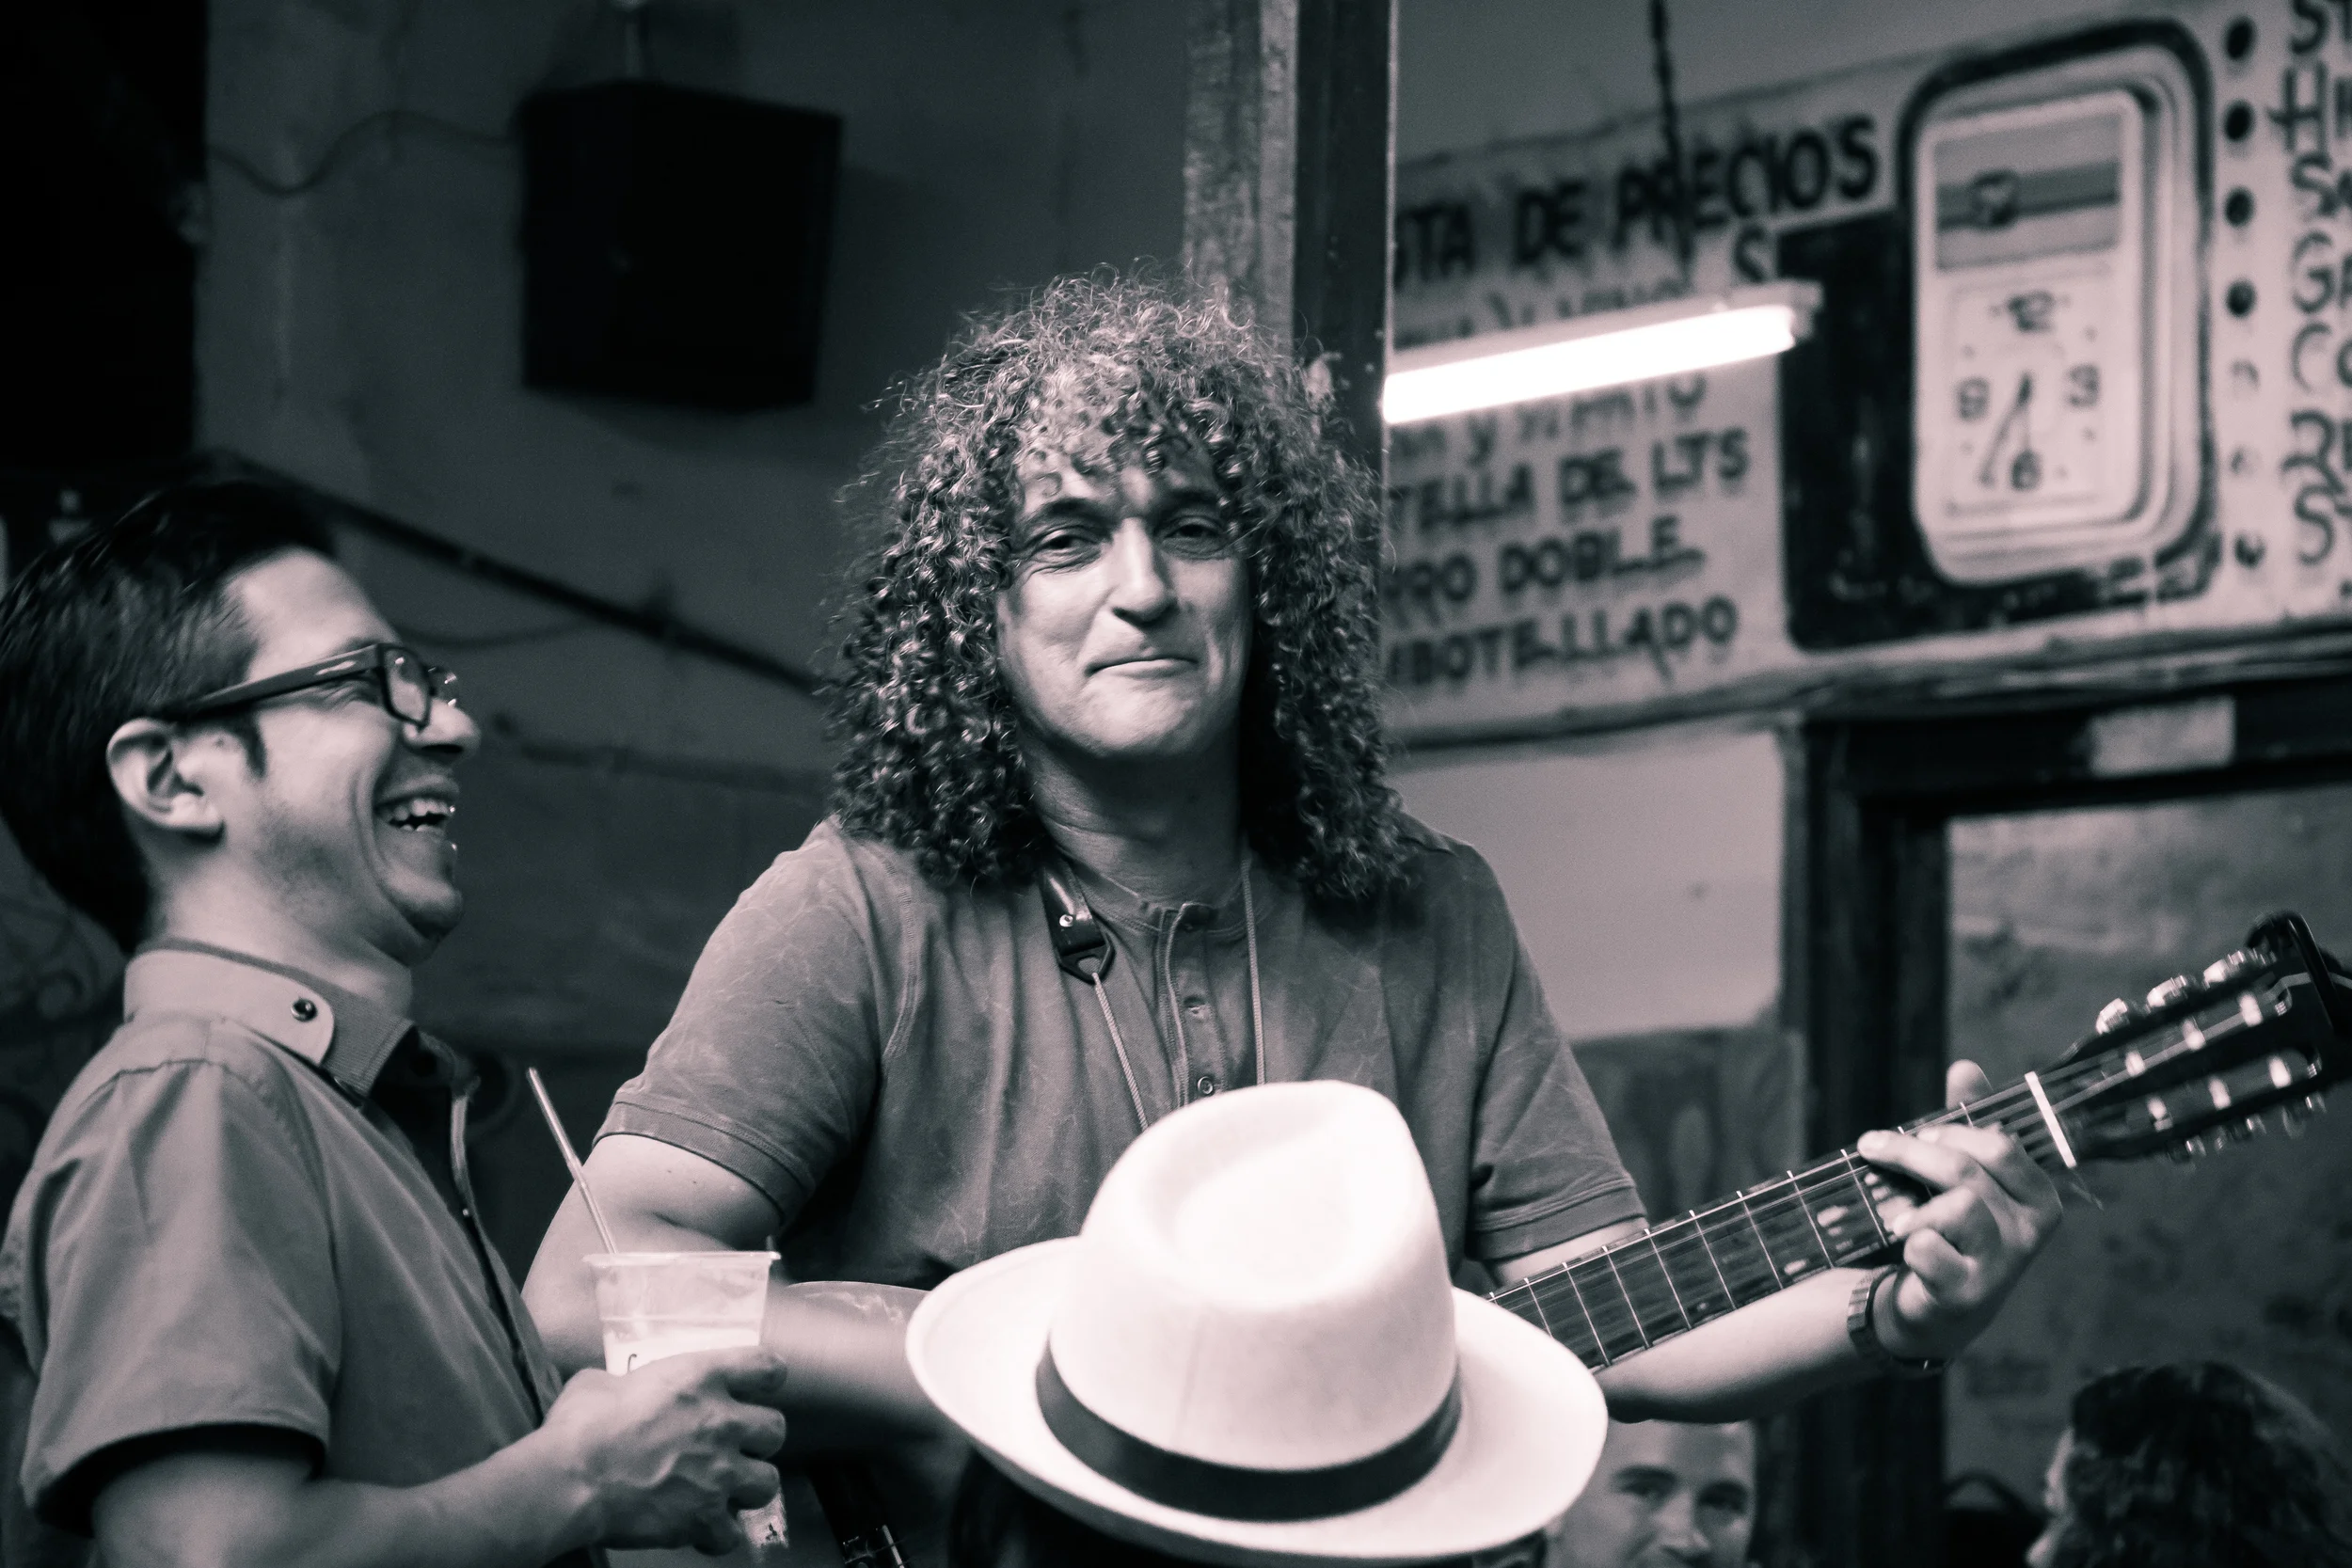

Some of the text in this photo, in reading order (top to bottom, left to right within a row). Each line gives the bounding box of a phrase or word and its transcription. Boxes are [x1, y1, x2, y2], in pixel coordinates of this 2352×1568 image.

[1517, 179, 1592, 265] DE
[1558, 446, 1637, 508] DE
[1650, 425, 1750, 499] LTS
[1500, 514, 1708, 598] DOBLE
